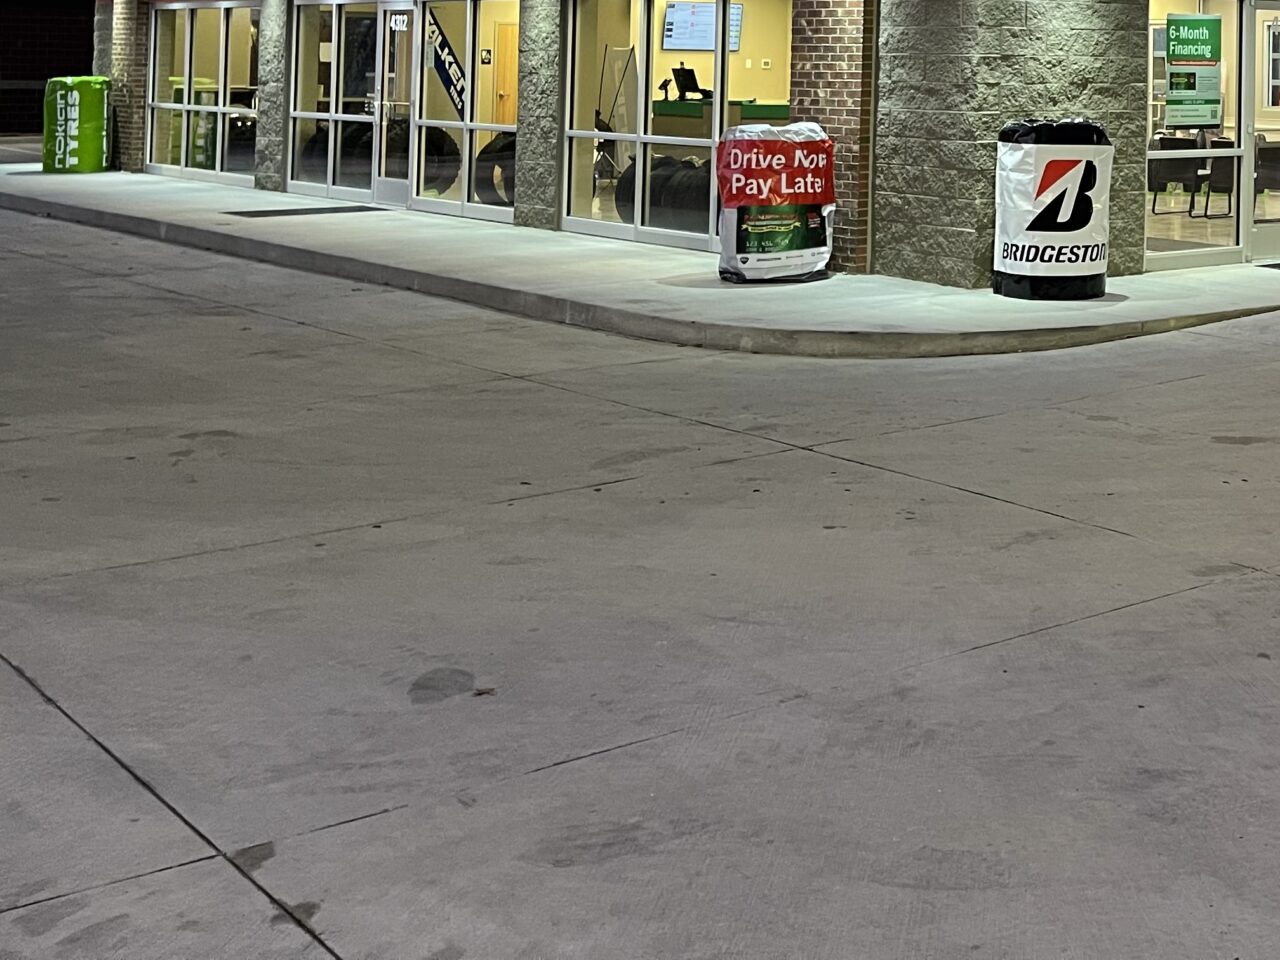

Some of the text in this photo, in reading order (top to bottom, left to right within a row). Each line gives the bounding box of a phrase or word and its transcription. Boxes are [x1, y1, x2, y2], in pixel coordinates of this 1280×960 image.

[390, 14, 408, 31] 4312
[1169, 26, 1209, 40] 6-Month
[428, 14, 466, 92] ALKEN
[1169, 42, 1212, 58] Financing
[65, 90, 80, 168] TYRES
[730, 148, 786, 170] Drive
[731, 173, 773, 199] Pay
[1002, 242, 1107, 263] BRIDGESTON
